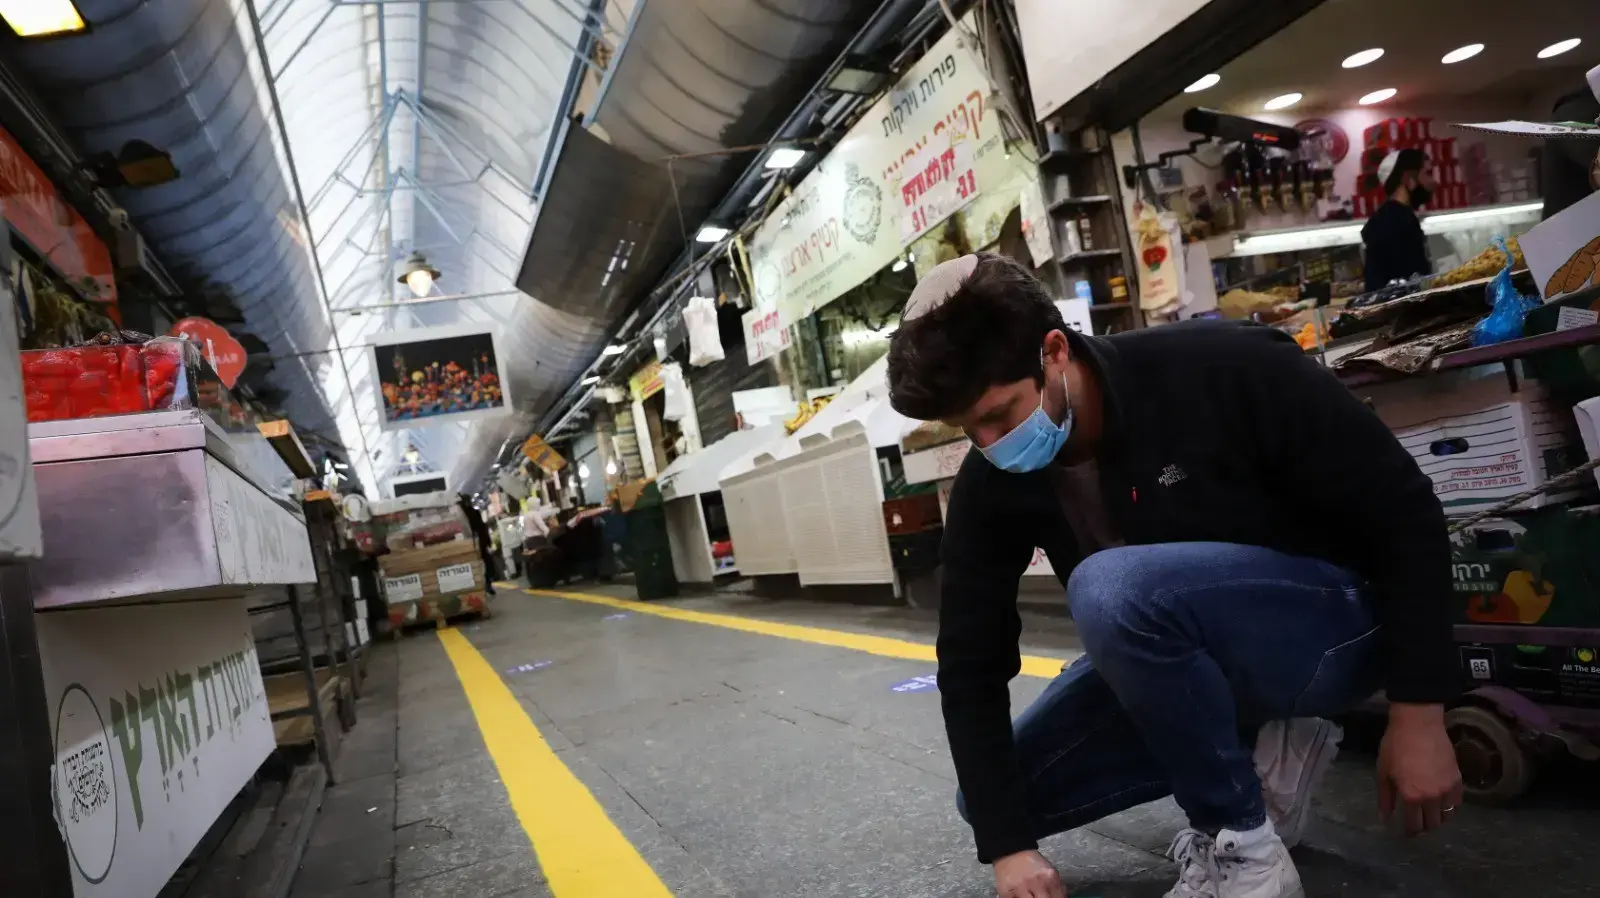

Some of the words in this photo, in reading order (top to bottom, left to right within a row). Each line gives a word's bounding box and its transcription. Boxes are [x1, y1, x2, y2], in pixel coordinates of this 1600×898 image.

[919, 54, 957, 102] פירות
[881, 89, 919, 138] וירקות
[811, 216, 839, 264] קטיף
[1473, 661, 1487, 673] 85
[1562, 663, 1573, 671] All
[1574, 664, 1589, 673] The
[109, 667, 201, 833] הארץ
